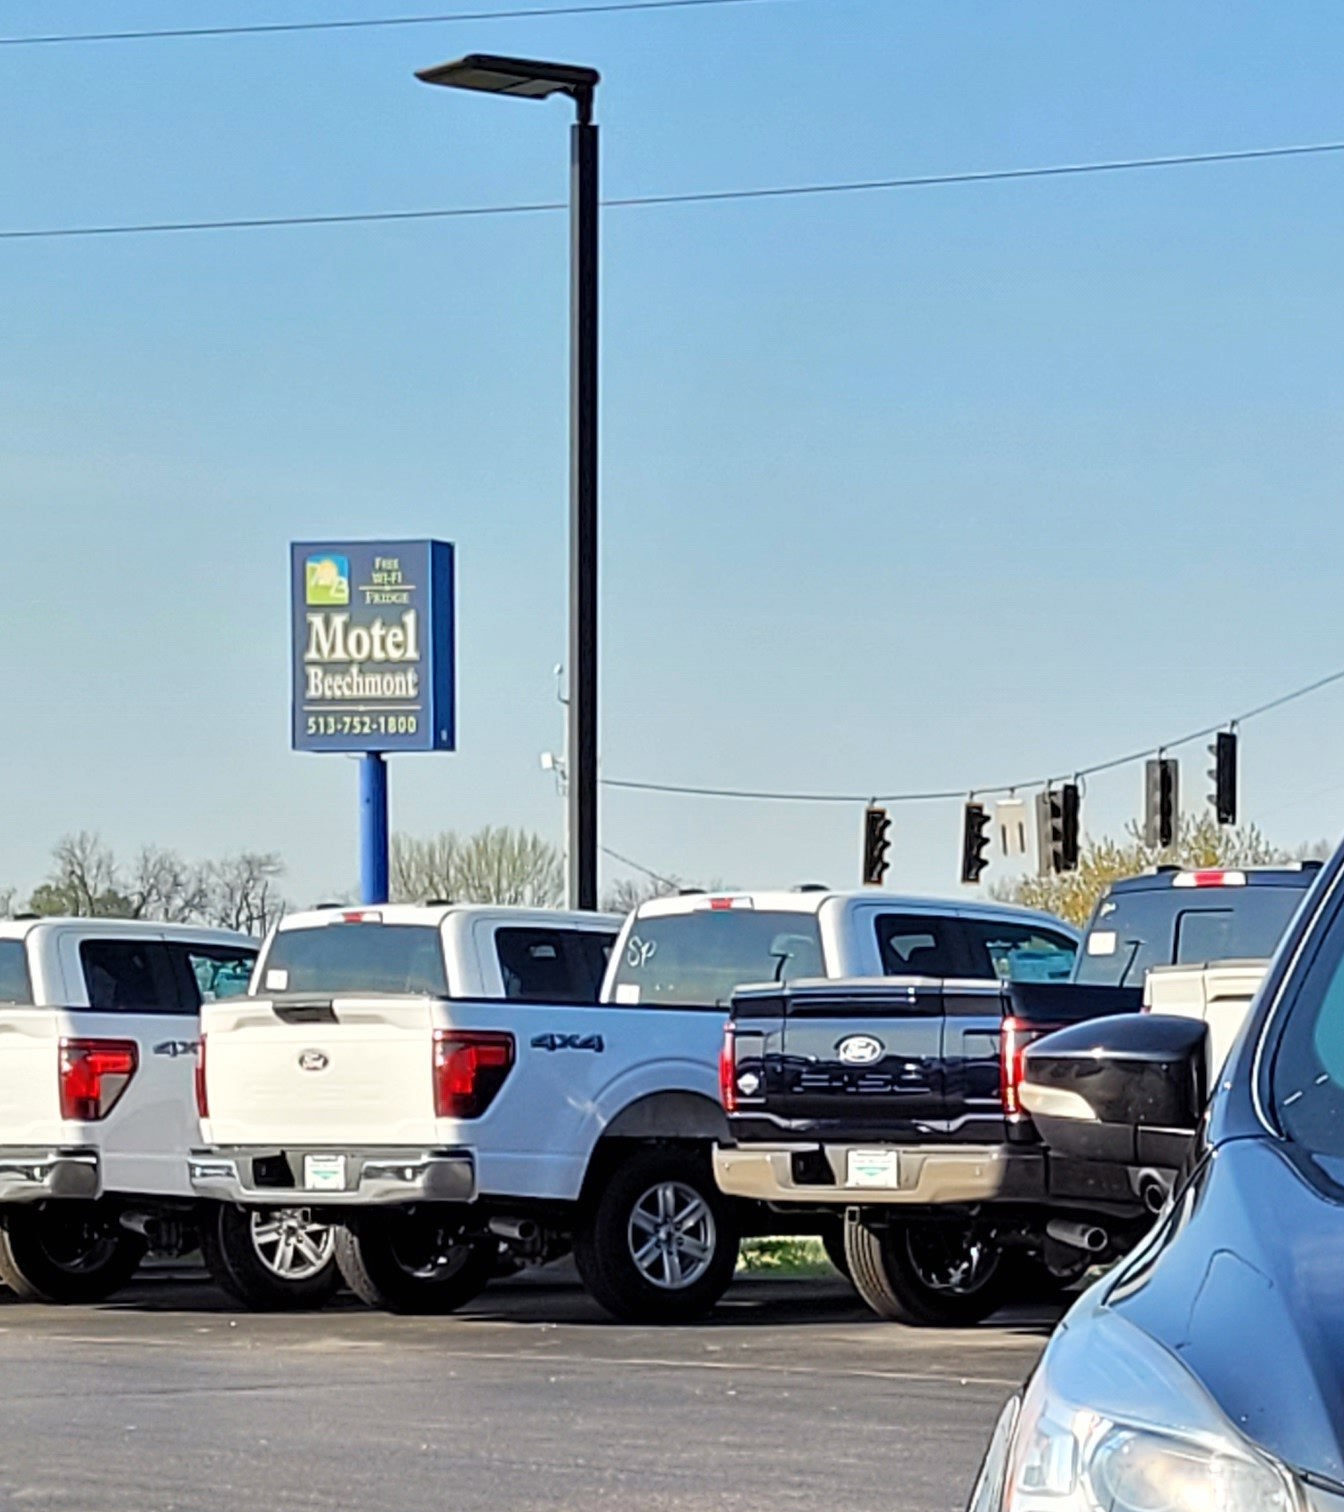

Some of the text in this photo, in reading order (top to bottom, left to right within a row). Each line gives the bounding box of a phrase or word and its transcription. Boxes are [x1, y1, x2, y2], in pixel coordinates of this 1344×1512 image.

[375, 556, 399, 569] FREE
[304, 609, 420, 661] Motel
[305, 663, 419, 699] Beechmont
